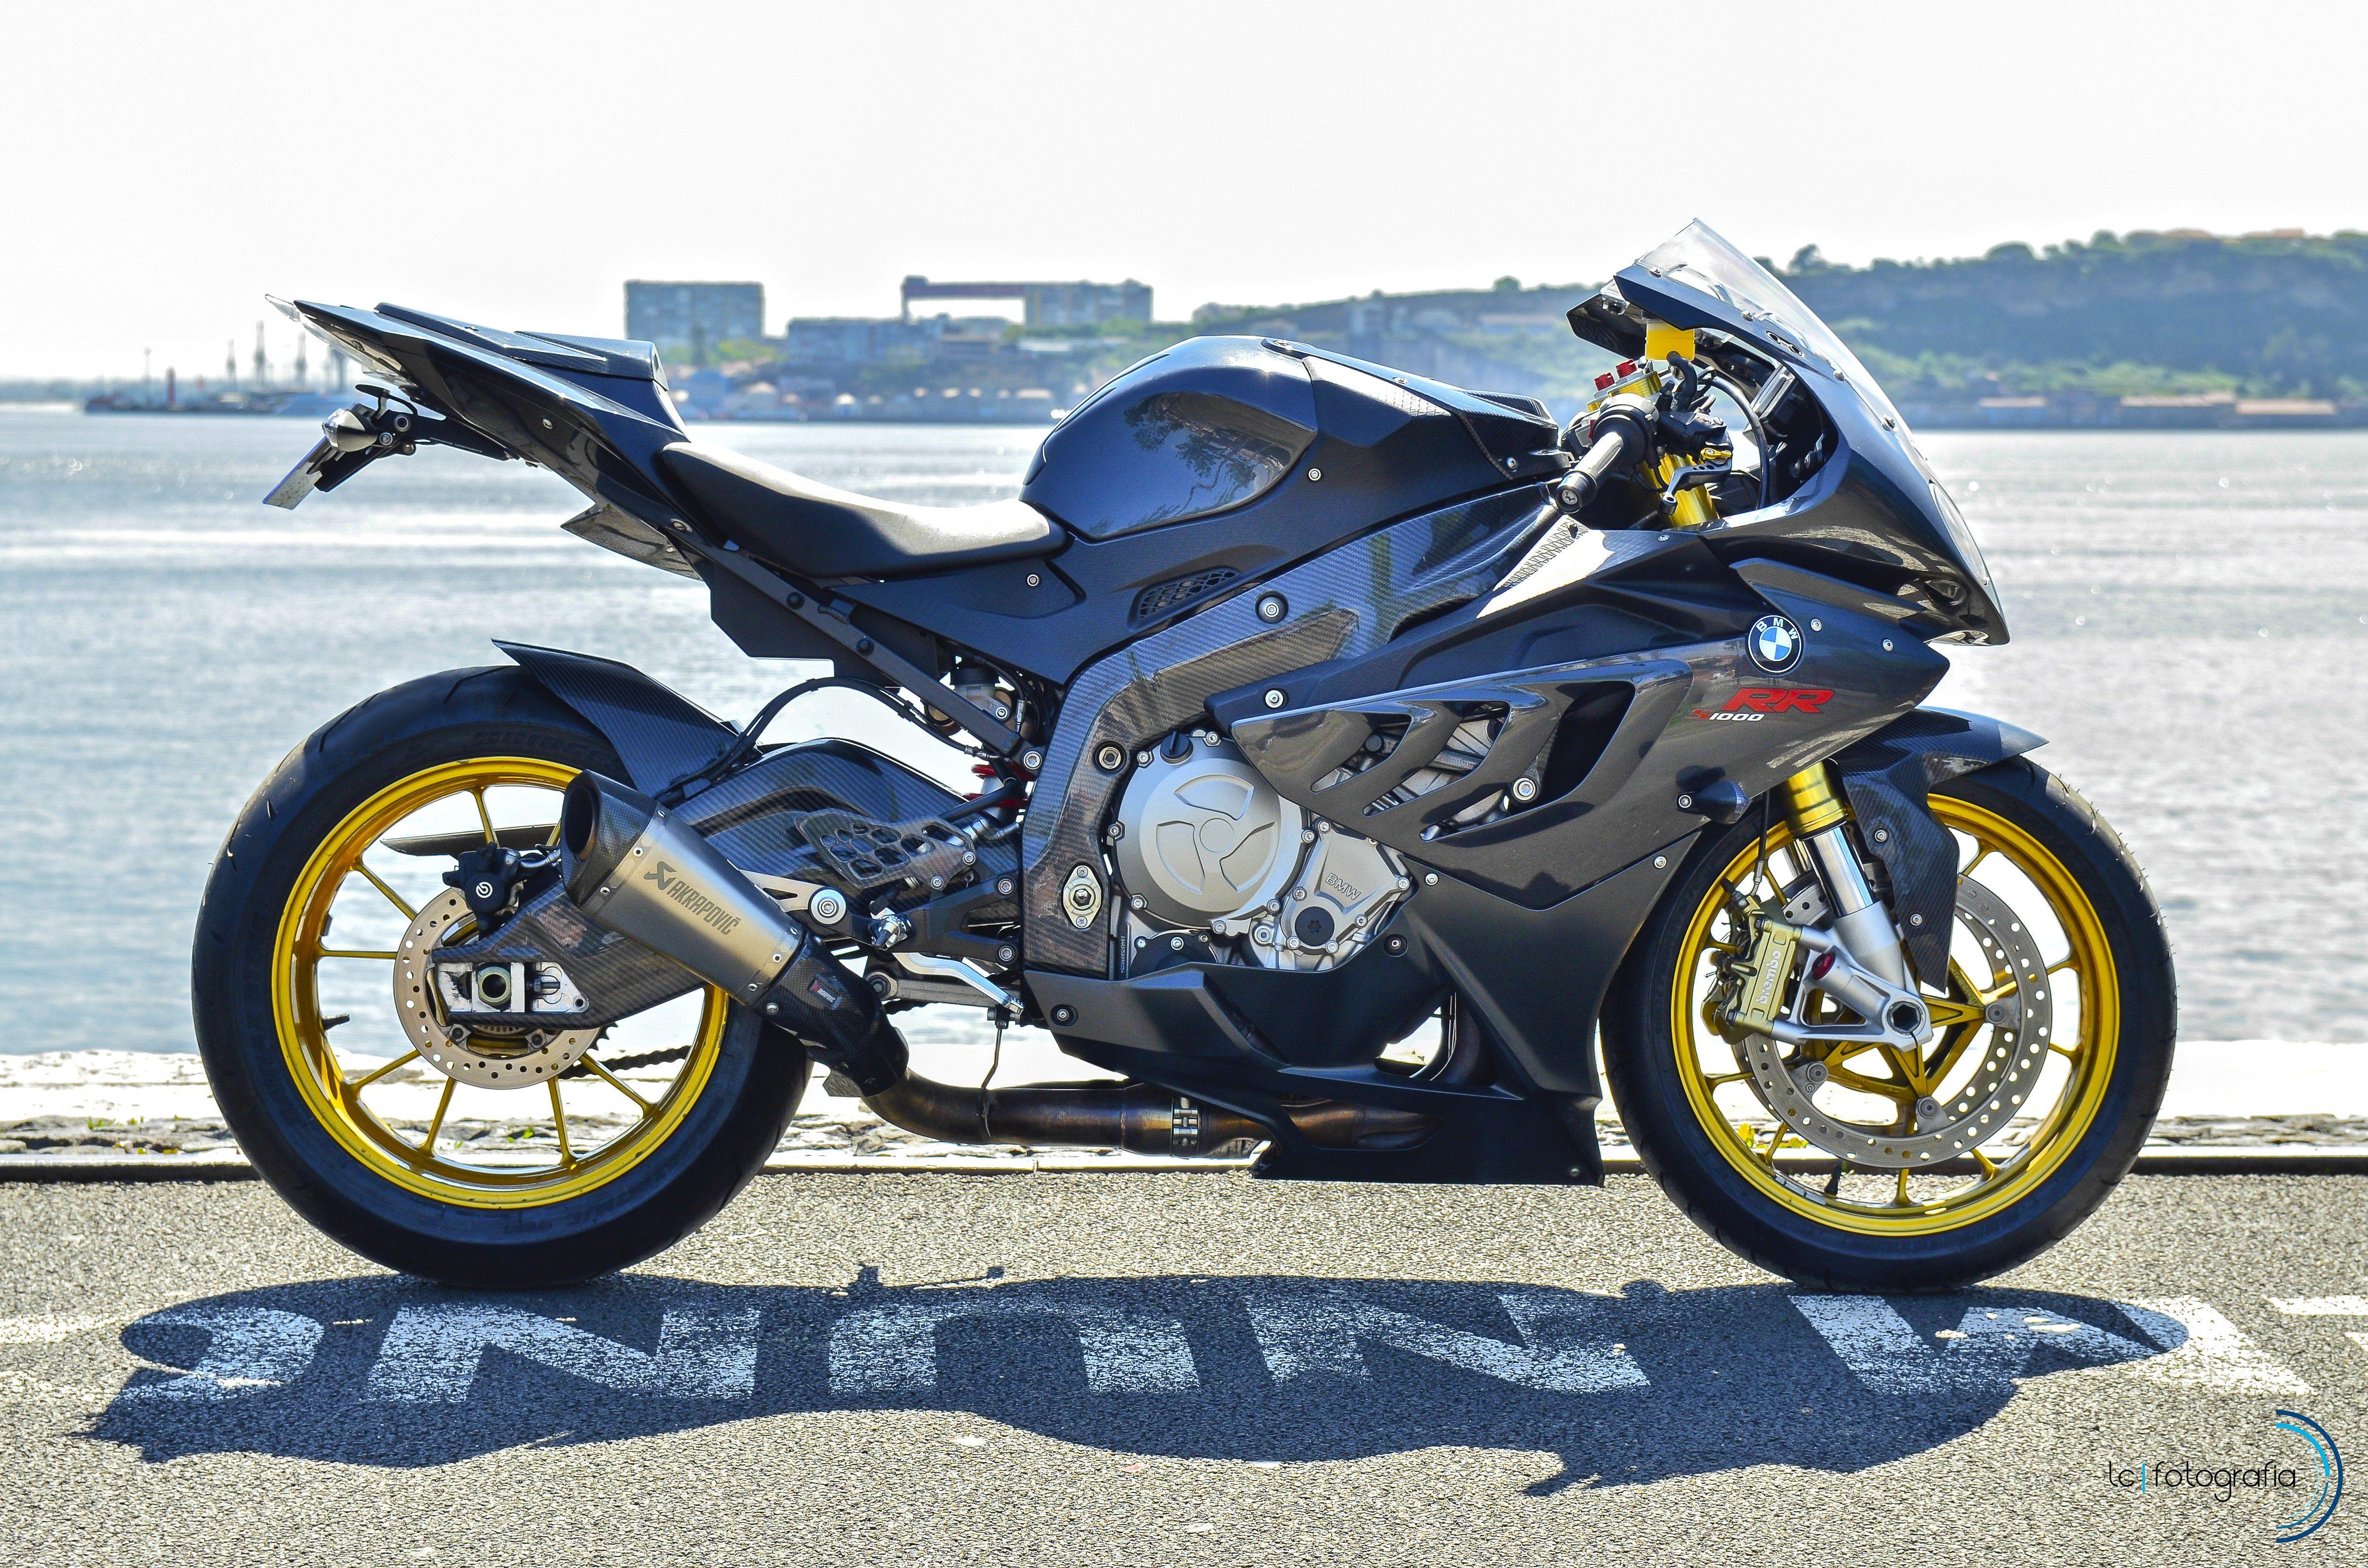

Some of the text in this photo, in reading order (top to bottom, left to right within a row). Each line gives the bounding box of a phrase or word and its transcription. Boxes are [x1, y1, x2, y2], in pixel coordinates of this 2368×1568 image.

[1756, 617, 1798, 639] BMW
[1719, 687, 1835, 713] RR
[1325, 872, 1361, 900] BMW
[1755, 950, 1781, 1004] brembo
